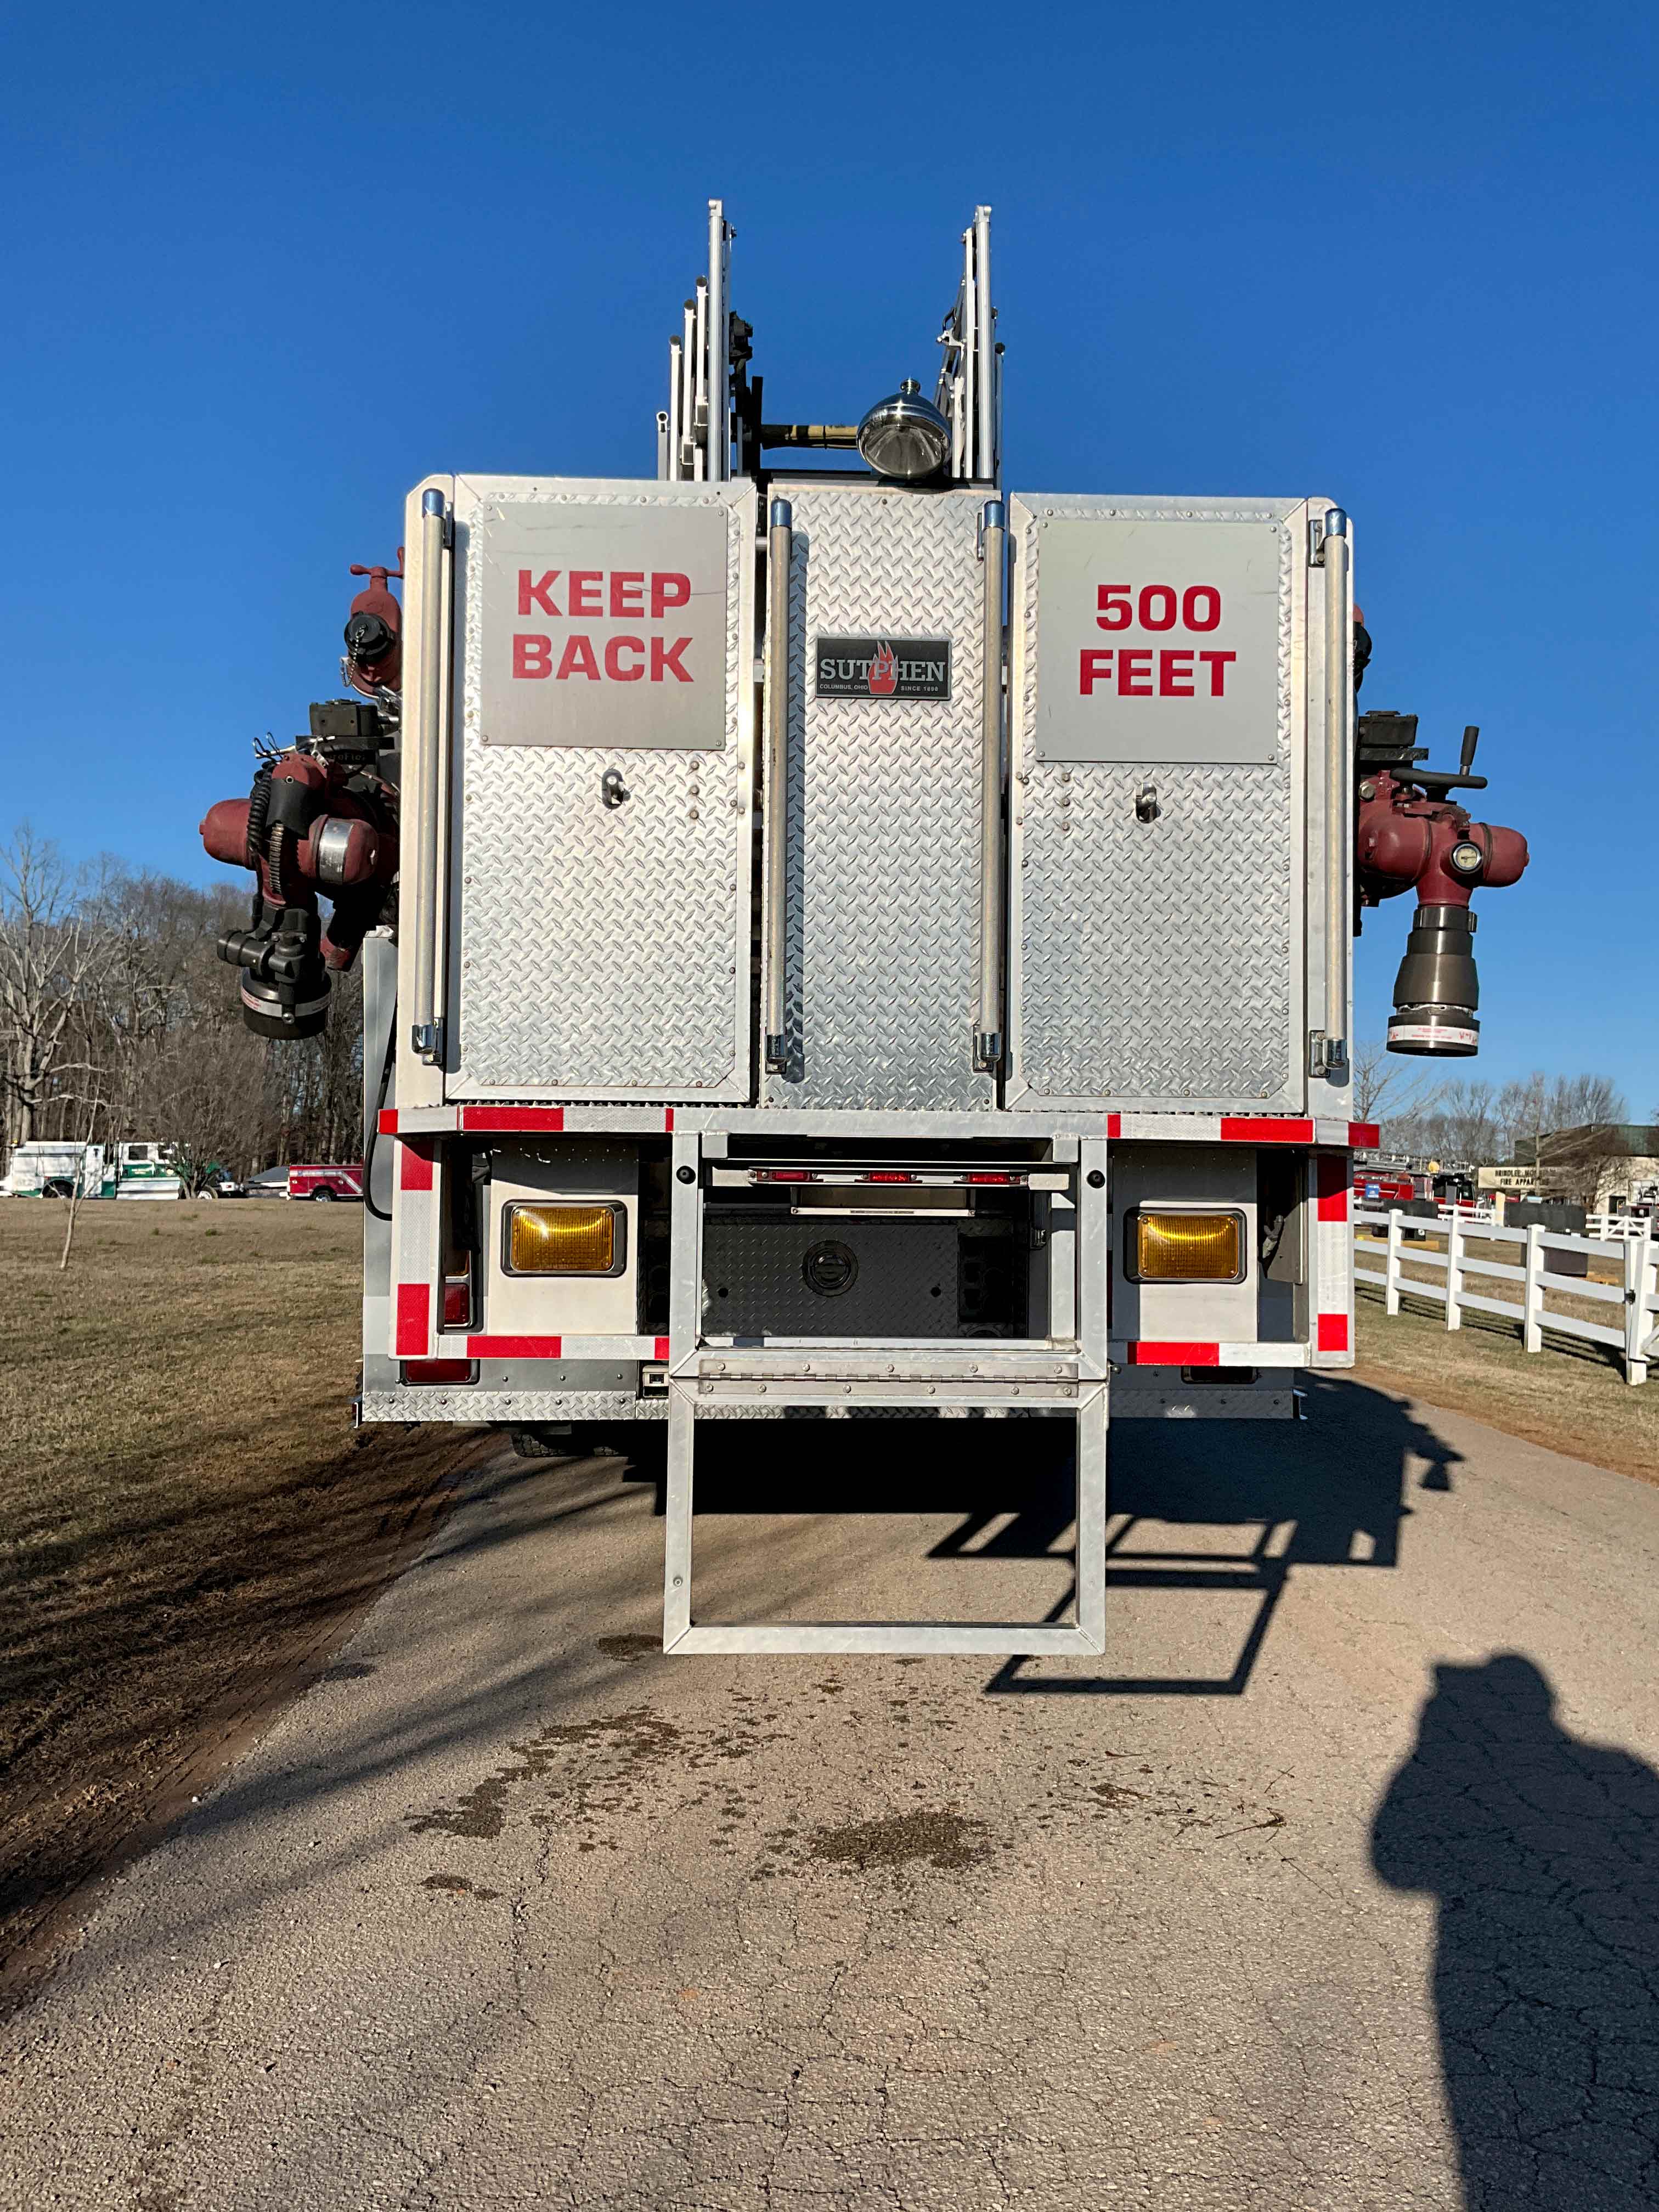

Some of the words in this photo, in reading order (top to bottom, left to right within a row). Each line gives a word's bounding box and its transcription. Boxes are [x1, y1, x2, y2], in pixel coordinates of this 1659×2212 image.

[518, 569, 691, 618] KEEP
[1096, 584, 1221, 632] 500
[512, 634, 695, 682] BACK
[820, 658, 945, 682] SUTPHEN
[1080, 649, 1237, 697] FEET
